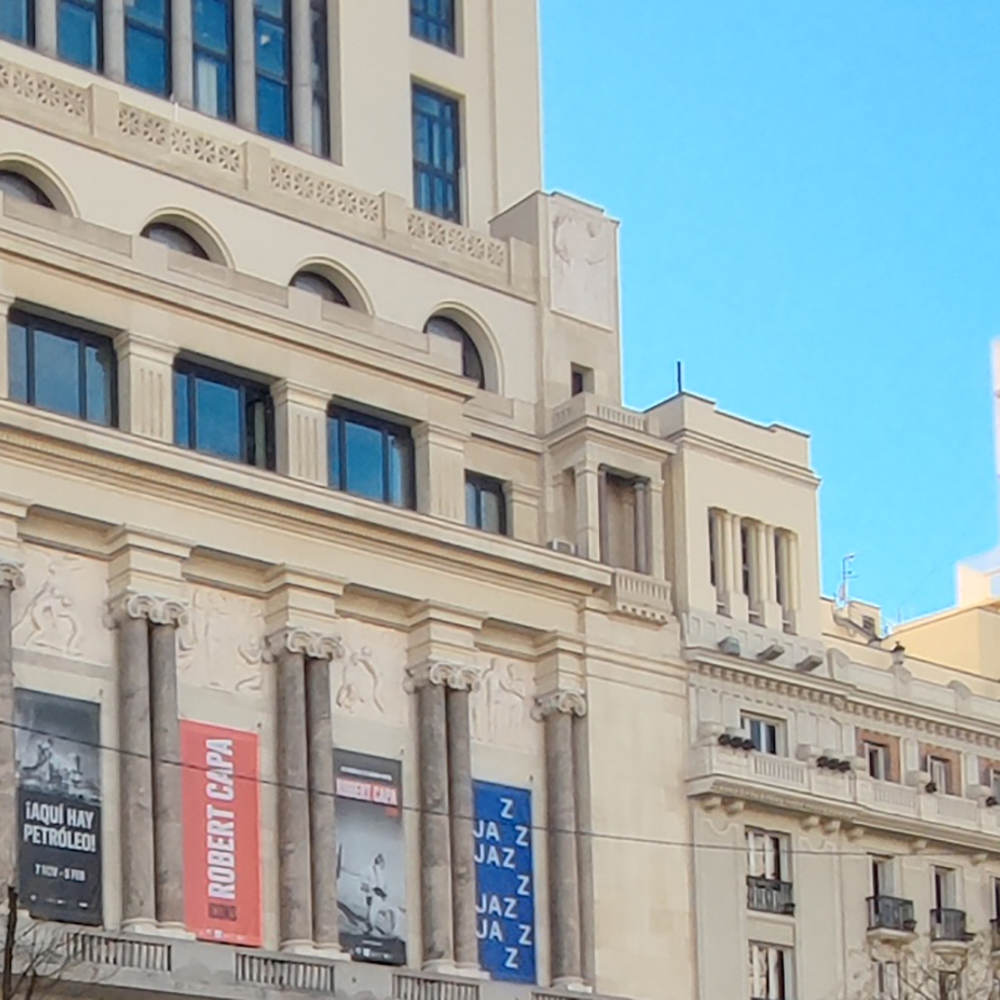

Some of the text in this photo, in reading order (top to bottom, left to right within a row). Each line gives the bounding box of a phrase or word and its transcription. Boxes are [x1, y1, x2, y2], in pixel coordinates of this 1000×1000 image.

[205, 739, 235, 801] CAPA
[25, 801, 94, 829] ¡AQUÍ HAY
[500, 798, 514, 820] Z
[23, 824, 96, 852] PETRÓLEO!
[206, 804, 236, 900] ROBERT
[474, 843, 516, 869] JAZ
[516, 875, 530, 896] Z
[475, 893, 518, 919] JAZ
[504, 947, 518, 969] Z
